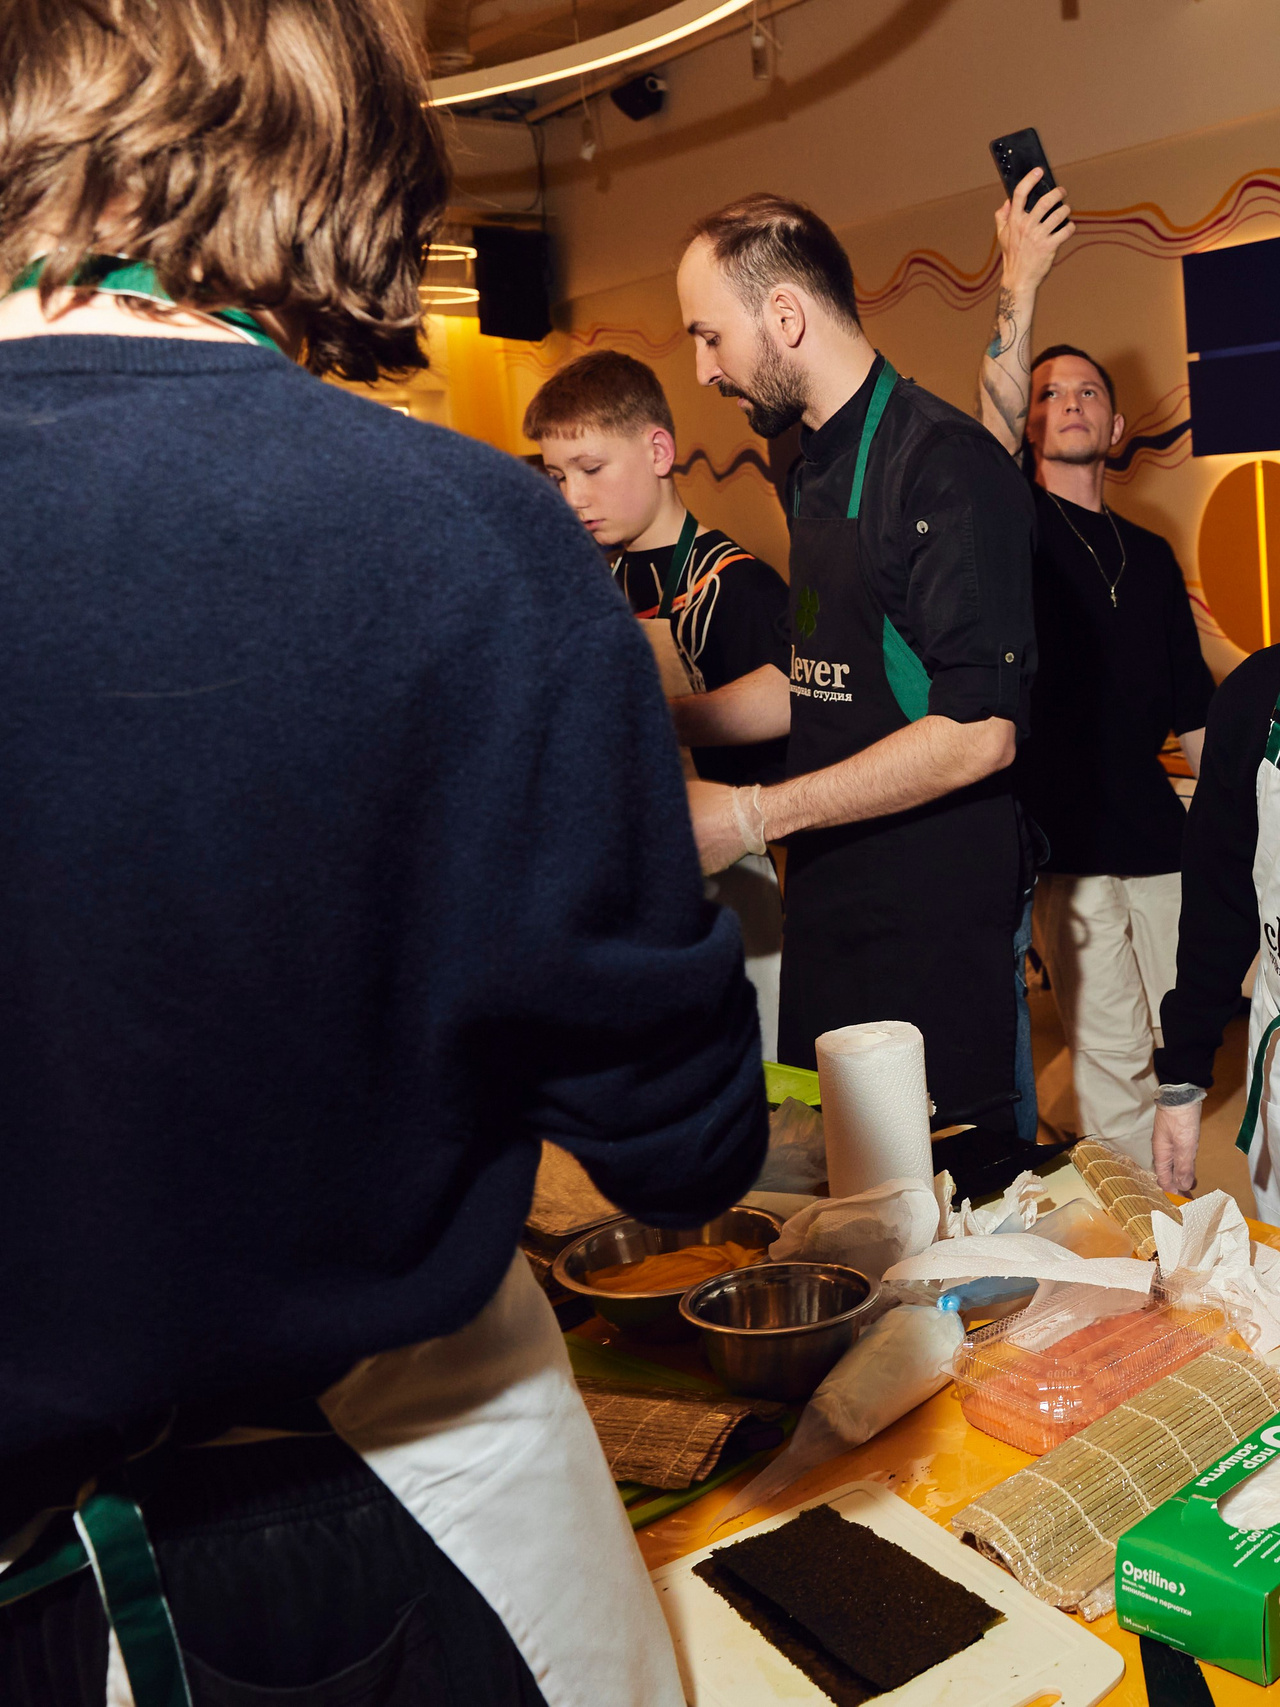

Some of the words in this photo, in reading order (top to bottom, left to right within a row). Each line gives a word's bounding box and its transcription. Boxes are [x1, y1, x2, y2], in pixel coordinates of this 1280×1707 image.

[813, 689, 853, 702] студия
[1195, 1443, 1259, 1487] защиты
[1242, 1447, 1277, 1470] пар
[1122, 1560, 1178, 1594] Optiline
[1121, 1584, 1158, 1603] виниловые
[1159, 1598, 1192, 1617] перчатки
